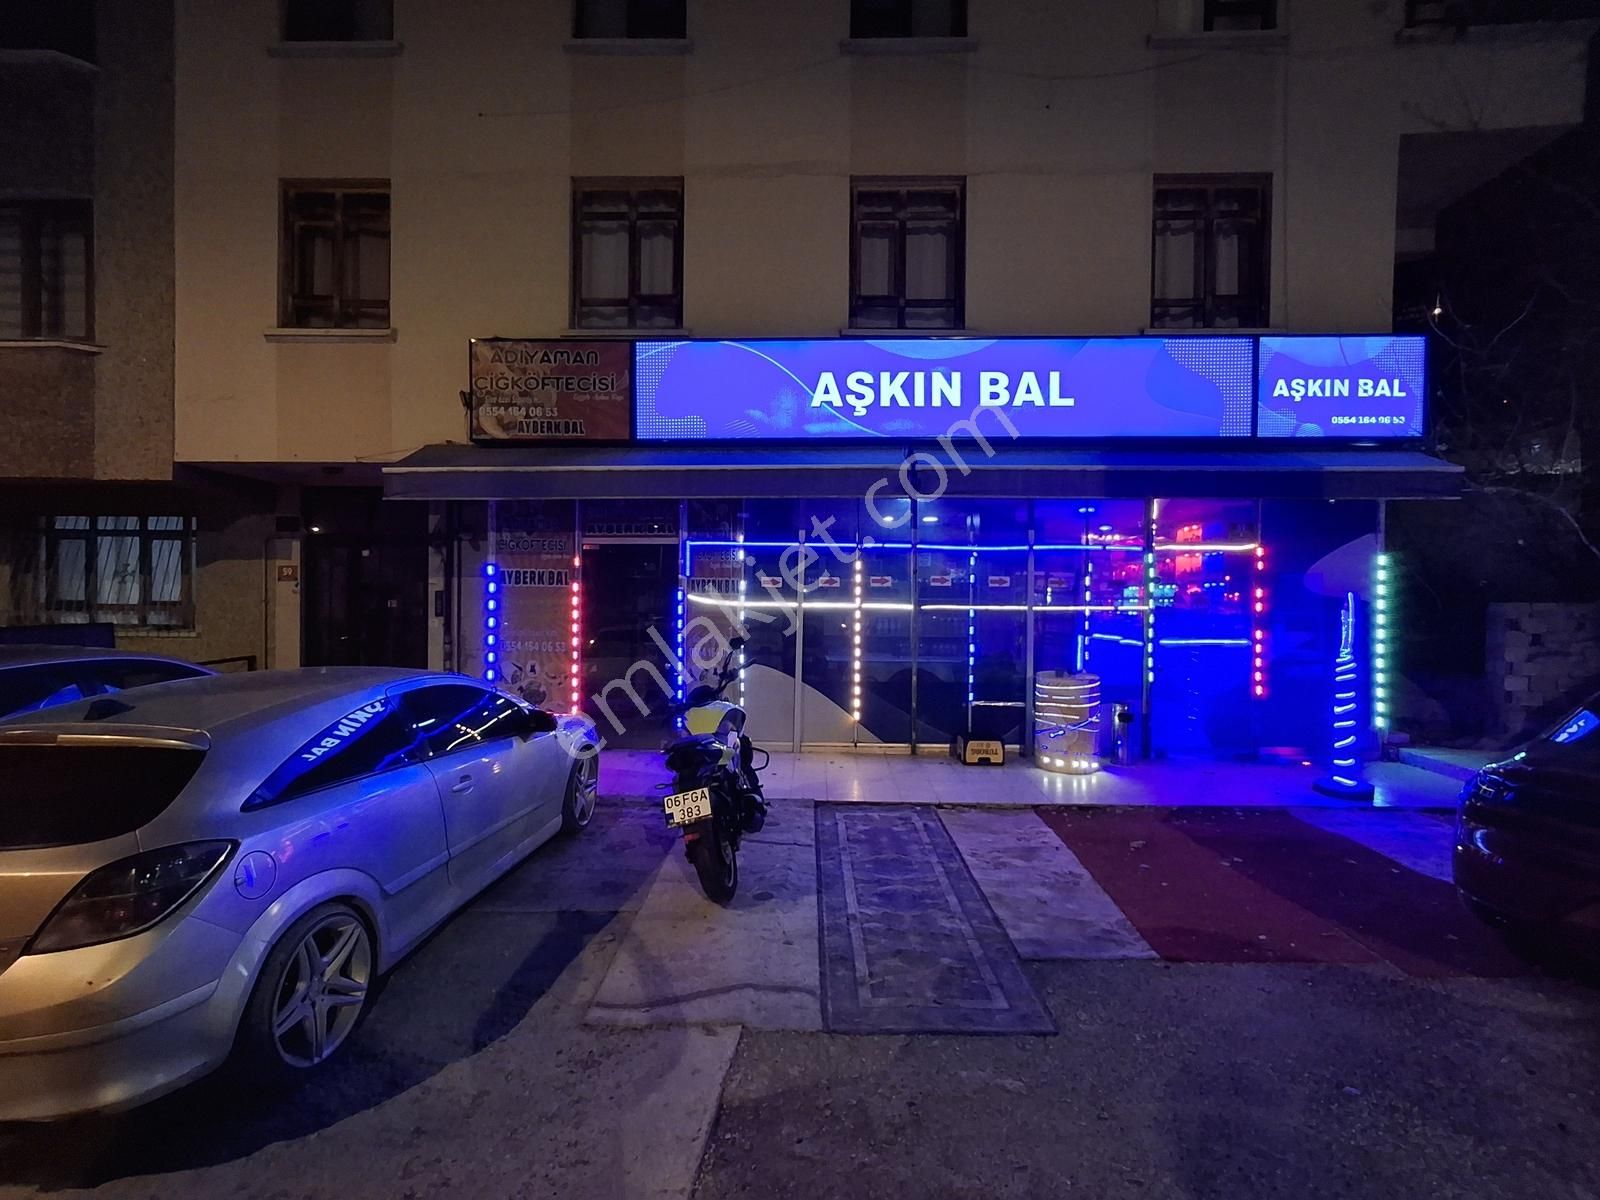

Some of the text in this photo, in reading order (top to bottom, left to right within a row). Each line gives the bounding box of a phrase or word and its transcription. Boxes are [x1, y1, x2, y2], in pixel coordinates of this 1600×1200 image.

[474, 372, 616, 394] ÇİĞKÖFTECİSİ
[1272, 378, 1407, 402] AŞKIN BAL
[811, 371, 1075, 416] AŞKIN BAL
[1331, 415, 1356, 425] 0554
[666, 790, 708, 809] 06 FGA
[678, 805, 701, 820] 383
